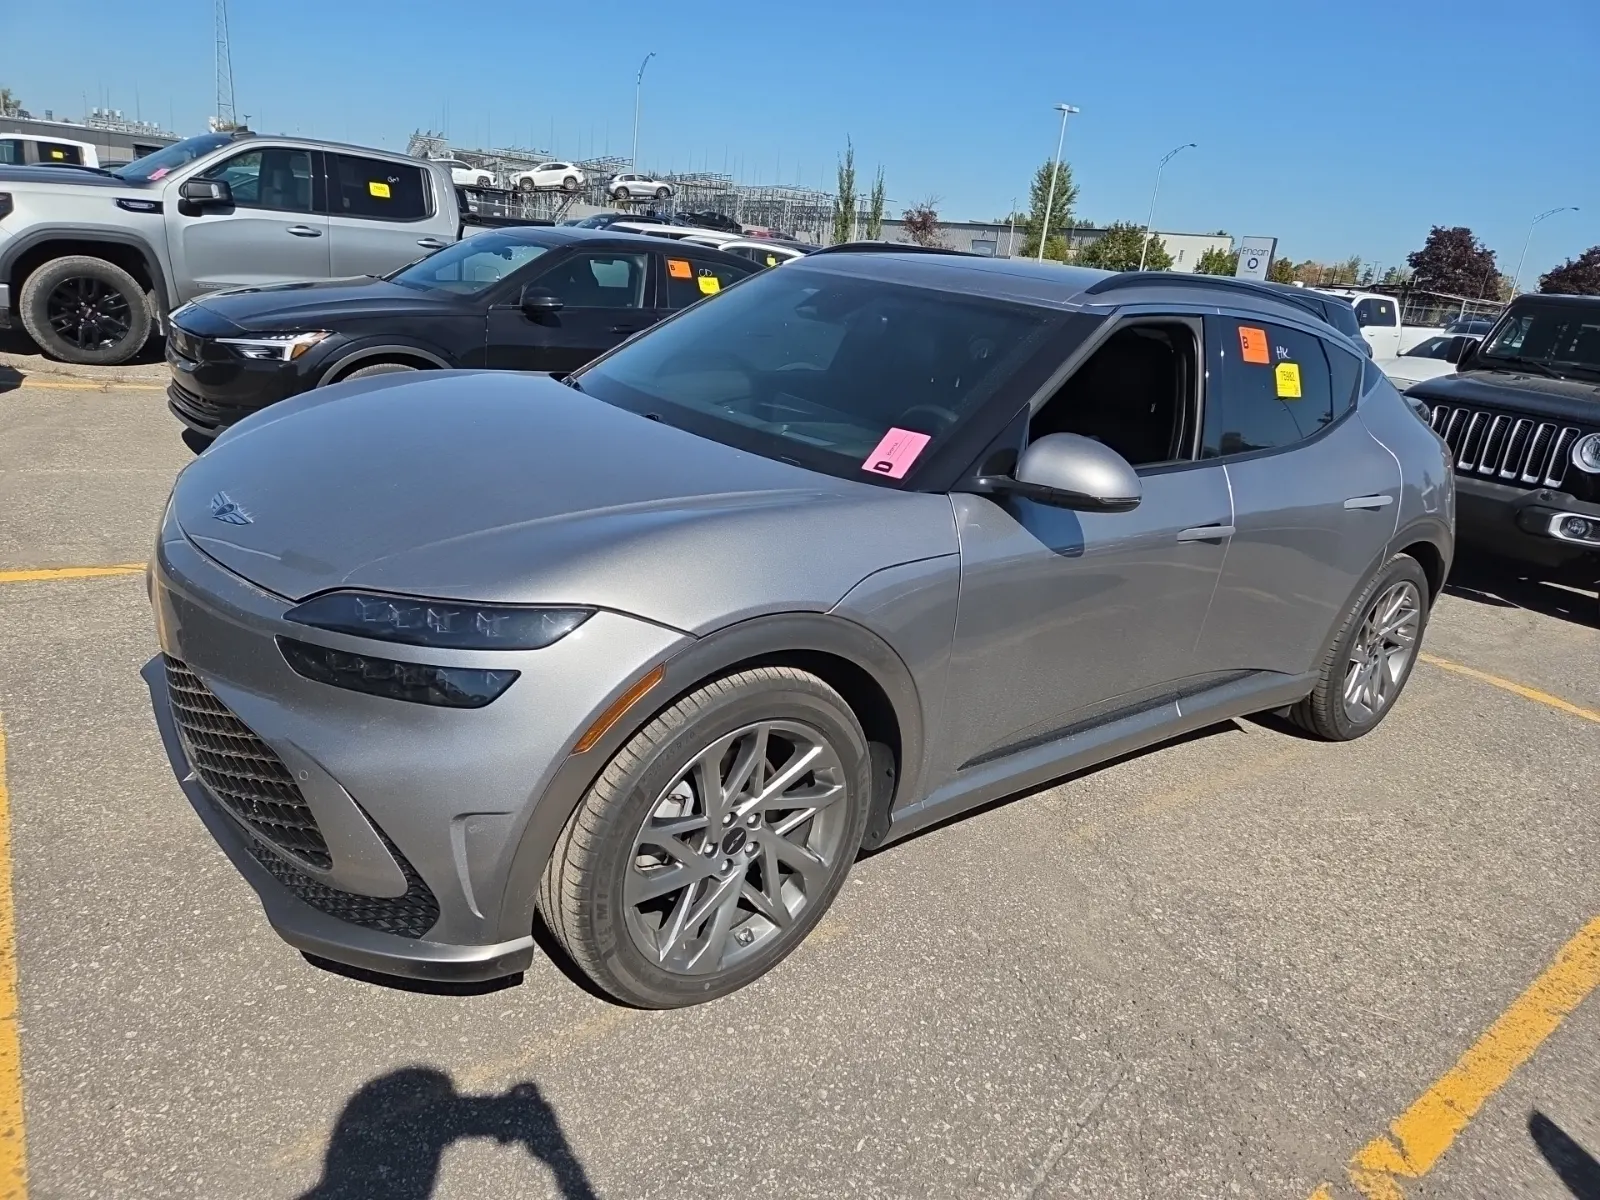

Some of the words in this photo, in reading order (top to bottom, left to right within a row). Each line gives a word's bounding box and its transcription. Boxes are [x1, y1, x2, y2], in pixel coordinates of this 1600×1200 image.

[1242, 246, 1269, 256] Encan
[1242, 335, 1249, 350] B
[1276, 346, 1291, 359] HK
[873, 460, 894, 474] D
